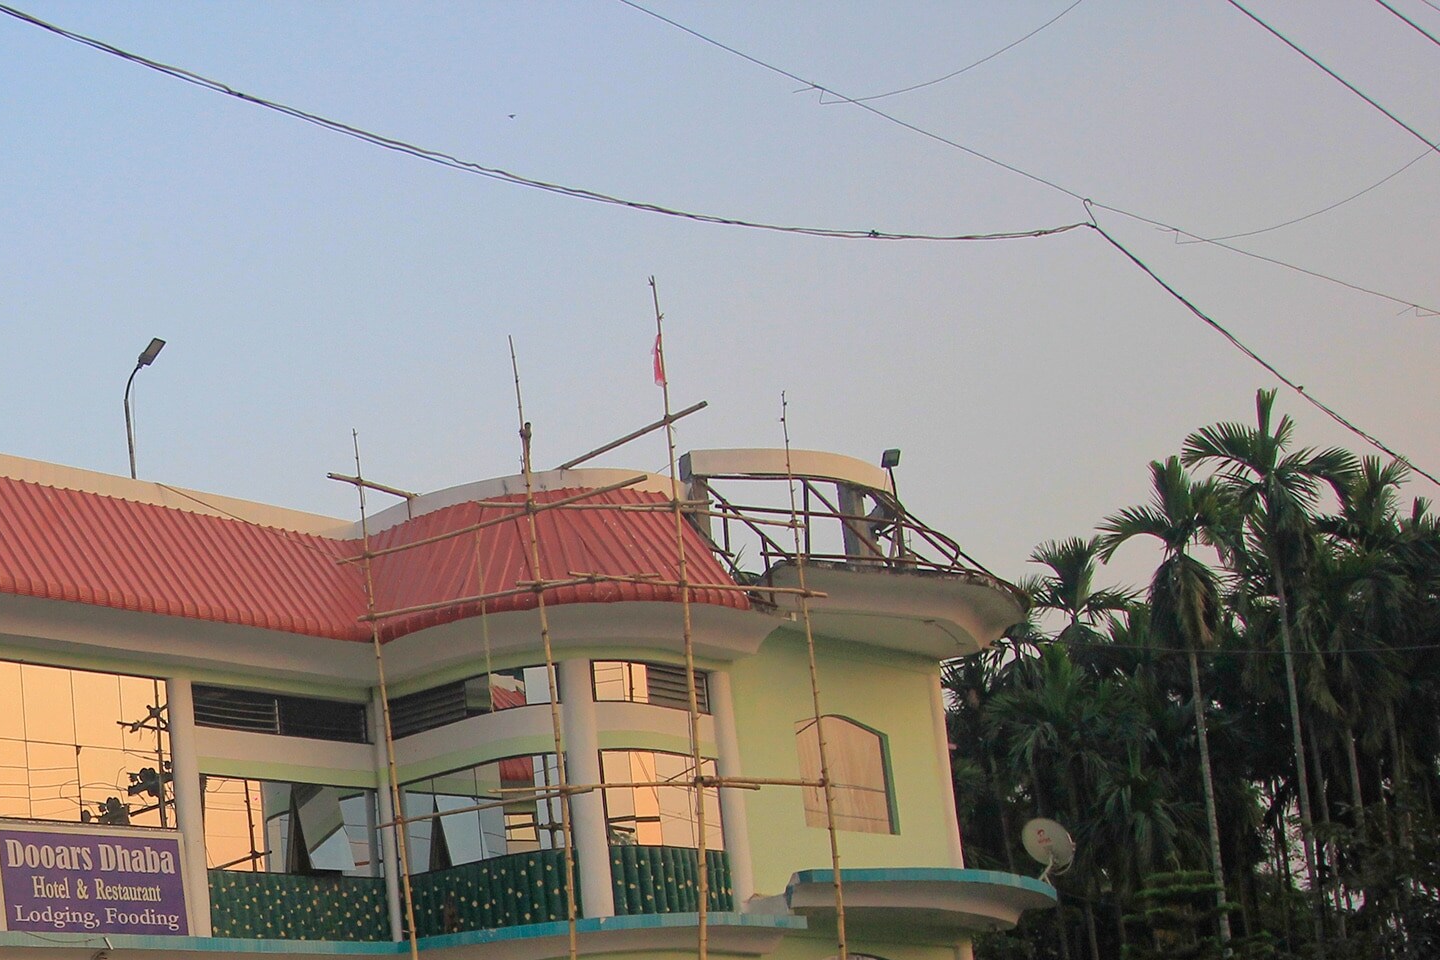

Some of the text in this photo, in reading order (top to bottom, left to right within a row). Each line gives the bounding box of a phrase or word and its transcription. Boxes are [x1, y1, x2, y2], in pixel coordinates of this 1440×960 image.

[5, 839, 176, 874] Dooars Dhaba
[32, 876, 161, 902] Hotel & Restaurant
[15, 905, 180, 931] Lodging, Fooding
